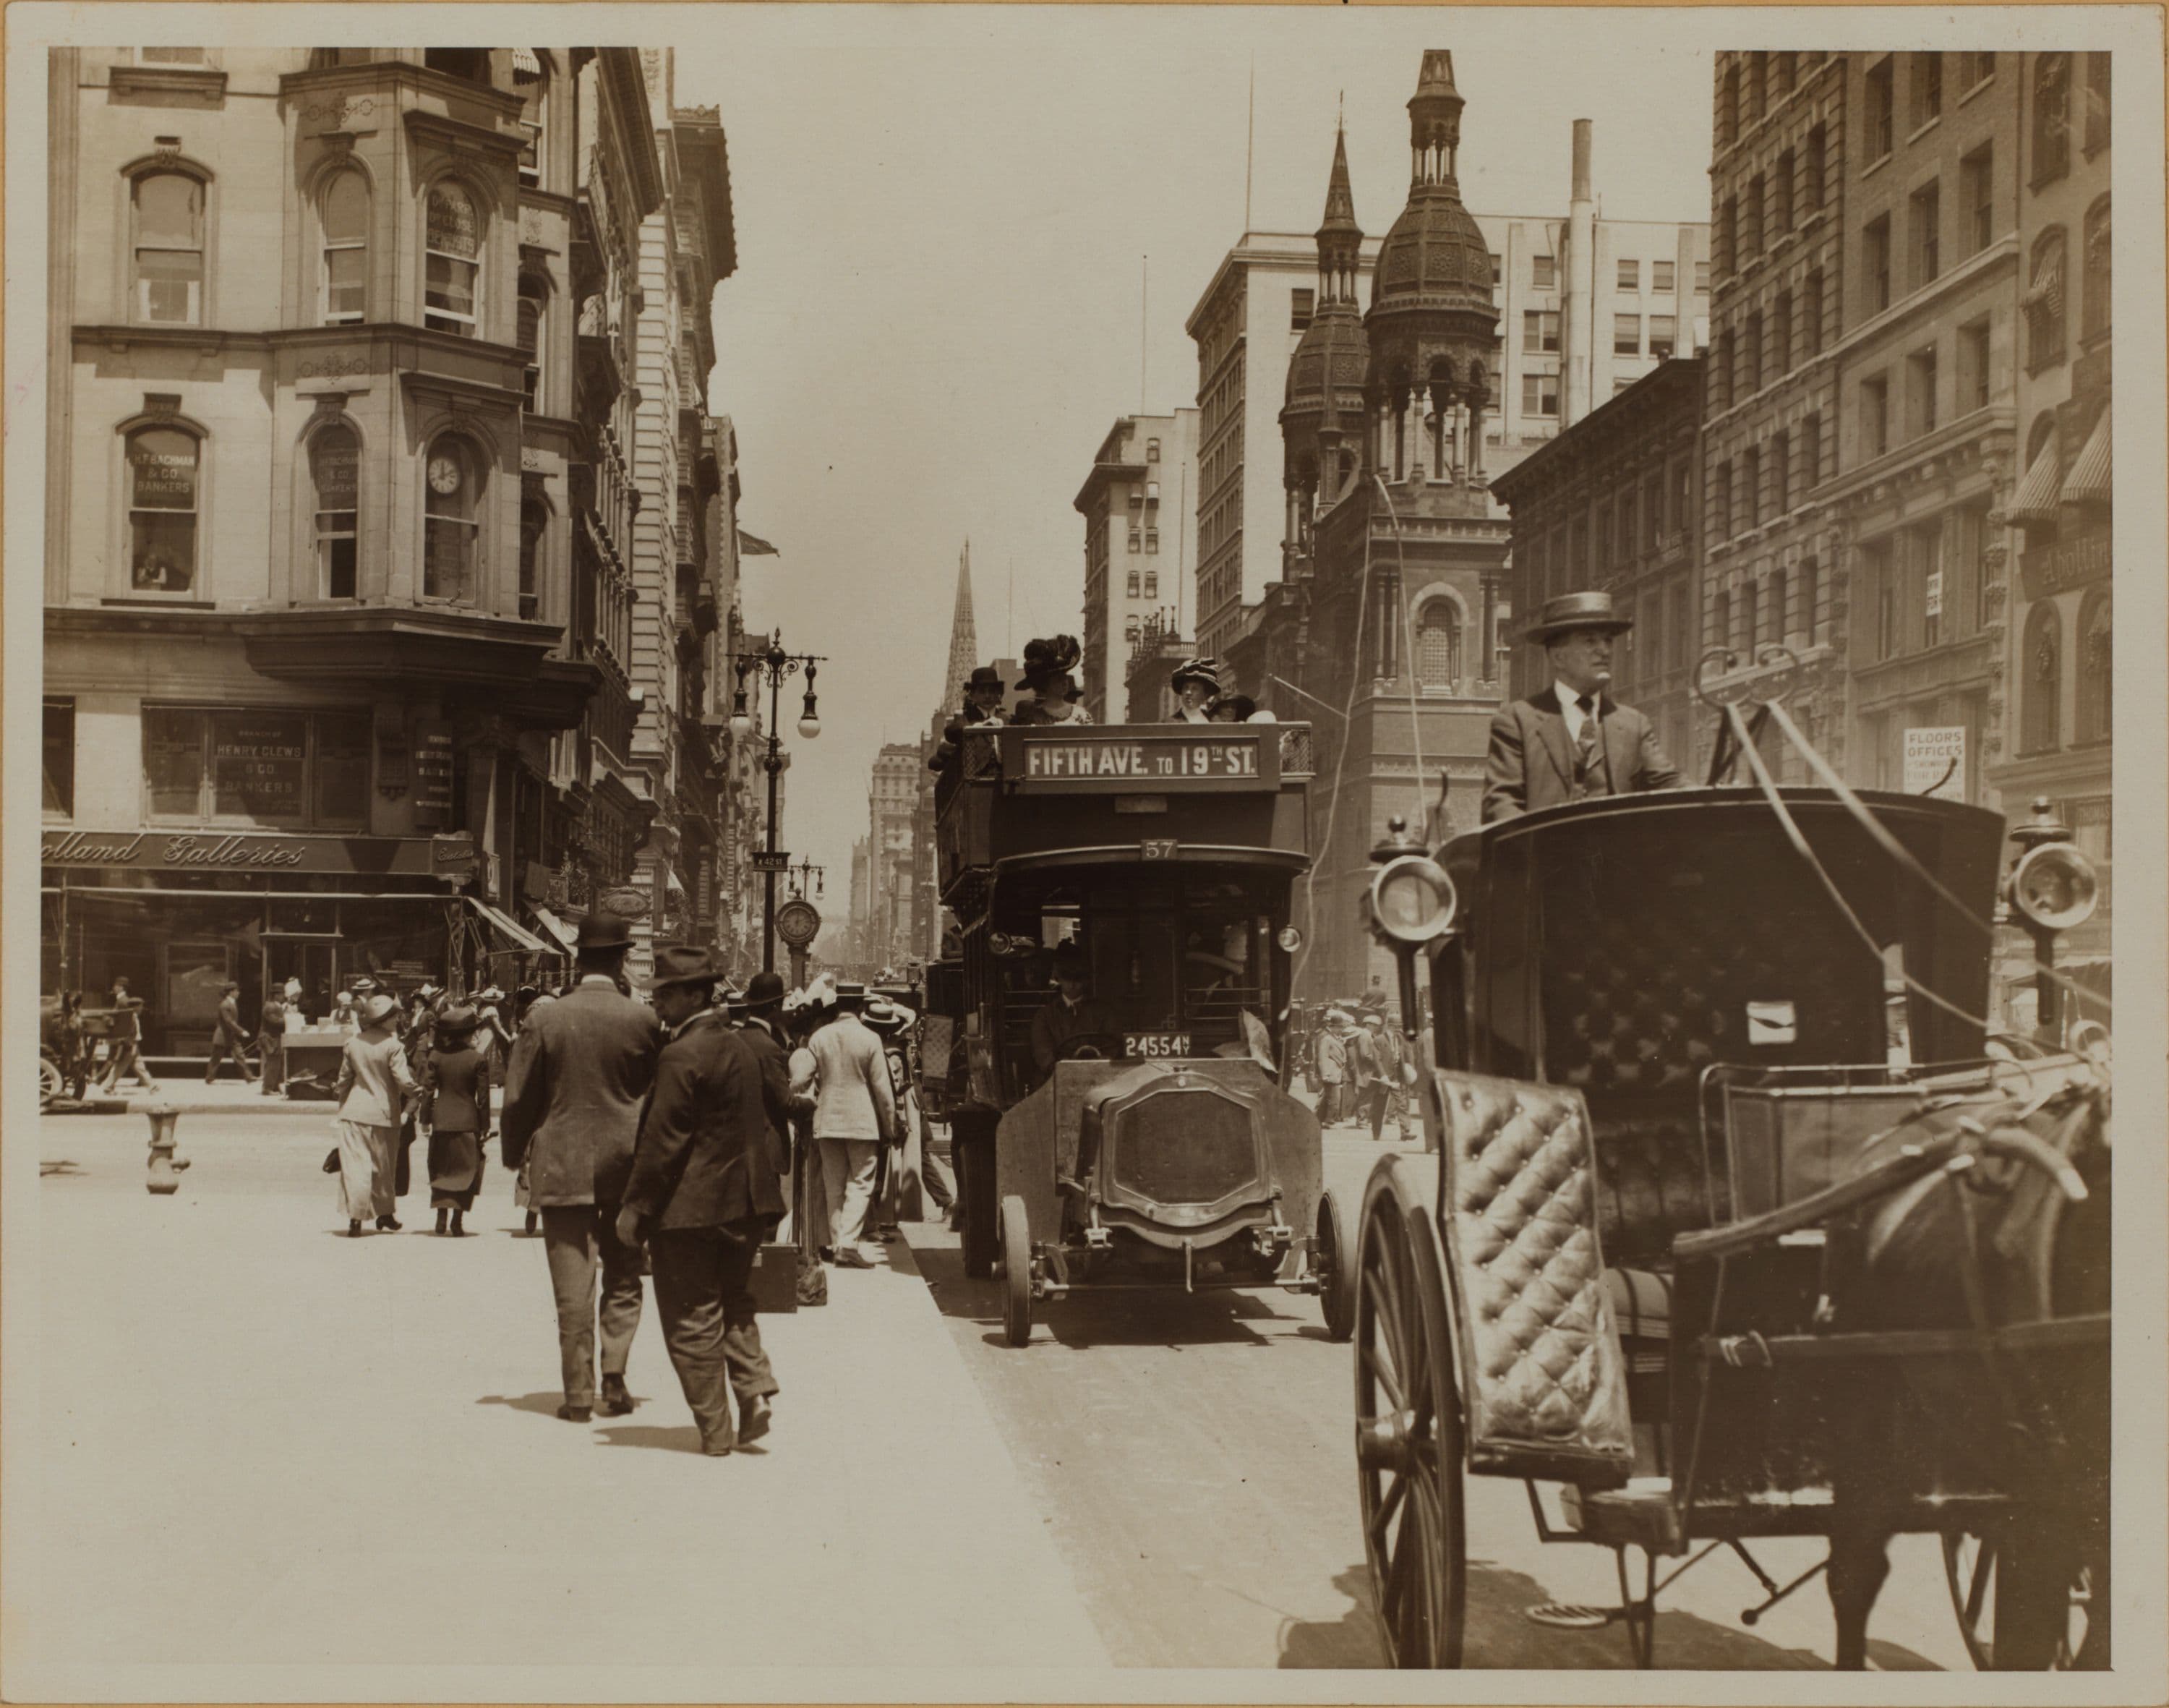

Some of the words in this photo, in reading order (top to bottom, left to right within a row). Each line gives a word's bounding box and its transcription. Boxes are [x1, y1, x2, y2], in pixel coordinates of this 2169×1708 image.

[150, 455, 194, 466] BACHMAN
[147, 468, 157, 479] &
[137, 481, 190, 493] BANKERS
[1909, 732, 1961, 743] FLOORS
[217, 745, 258, 757] HENRY
[262, 746, 301, 758] CLEWS
[1907, 745, 1963, 757] OFFICES
[1029, 748, 1093, 775] FIFTH
[1098, 747, 1149, 775] AVE.
[1156, 757, 1173, 774] TO
[1225, 746, 1256, 774] ST.
[225, 781, 293, 793] BANKERS
[163, 835, 307, 865] Galleries
[1146, 842, 1173, 858] 57
[763, 858, 774, 866] 42
[1125, 1036, 1181, 1056] 24554
